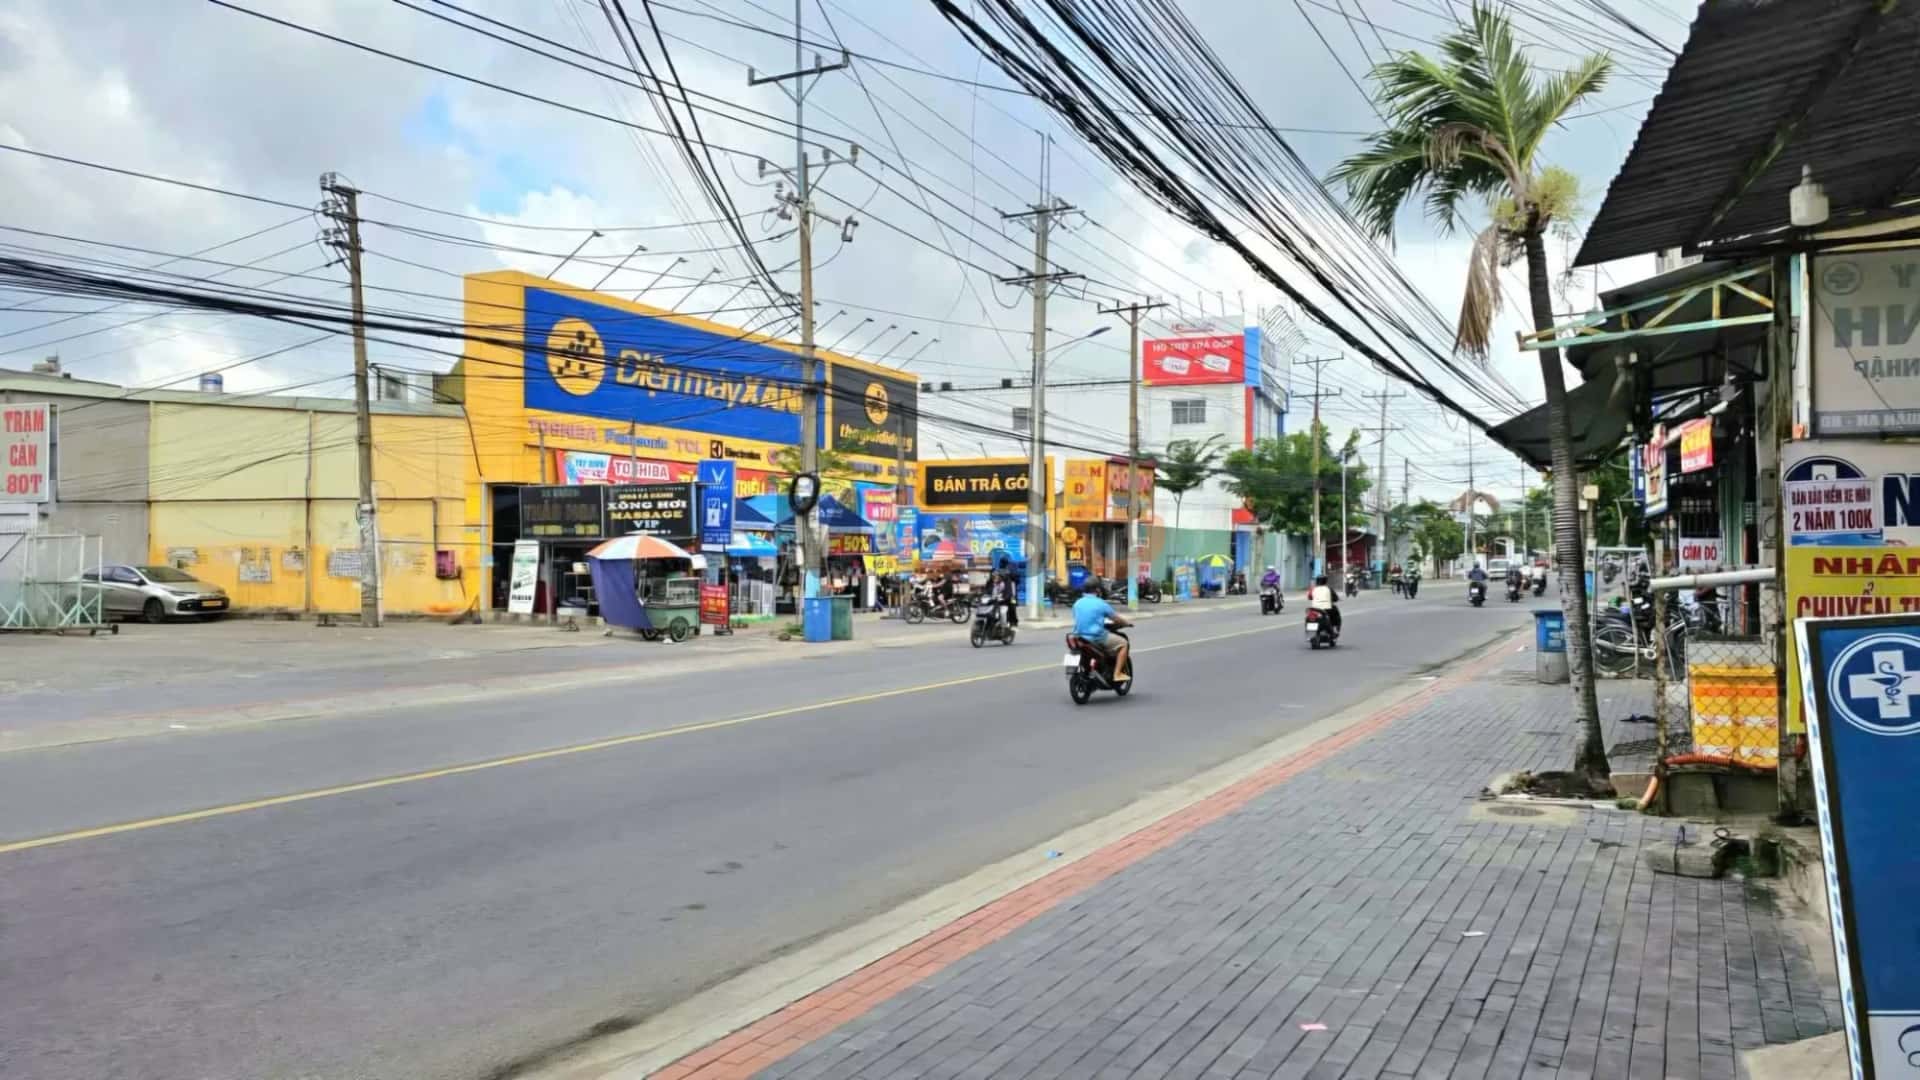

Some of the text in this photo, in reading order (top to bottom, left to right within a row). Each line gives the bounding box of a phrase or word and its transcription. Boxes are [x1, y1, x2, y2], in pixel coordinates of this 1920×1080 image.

[739, 374, 804, 414] XAN
[615, 461, 668, 478] TOHIBA
[7, 473, 42, 494] 80T
[933, 473, 1029, 492] BÁN TRẢ GÓ
[607, 499, 688, 510] XÔNG HƠI
[611, 511, 684, 520] MASSAGE
[633, 520, 661, 529] VIP
[1793, 507, 1873, 531] 2 NĂM 100K
